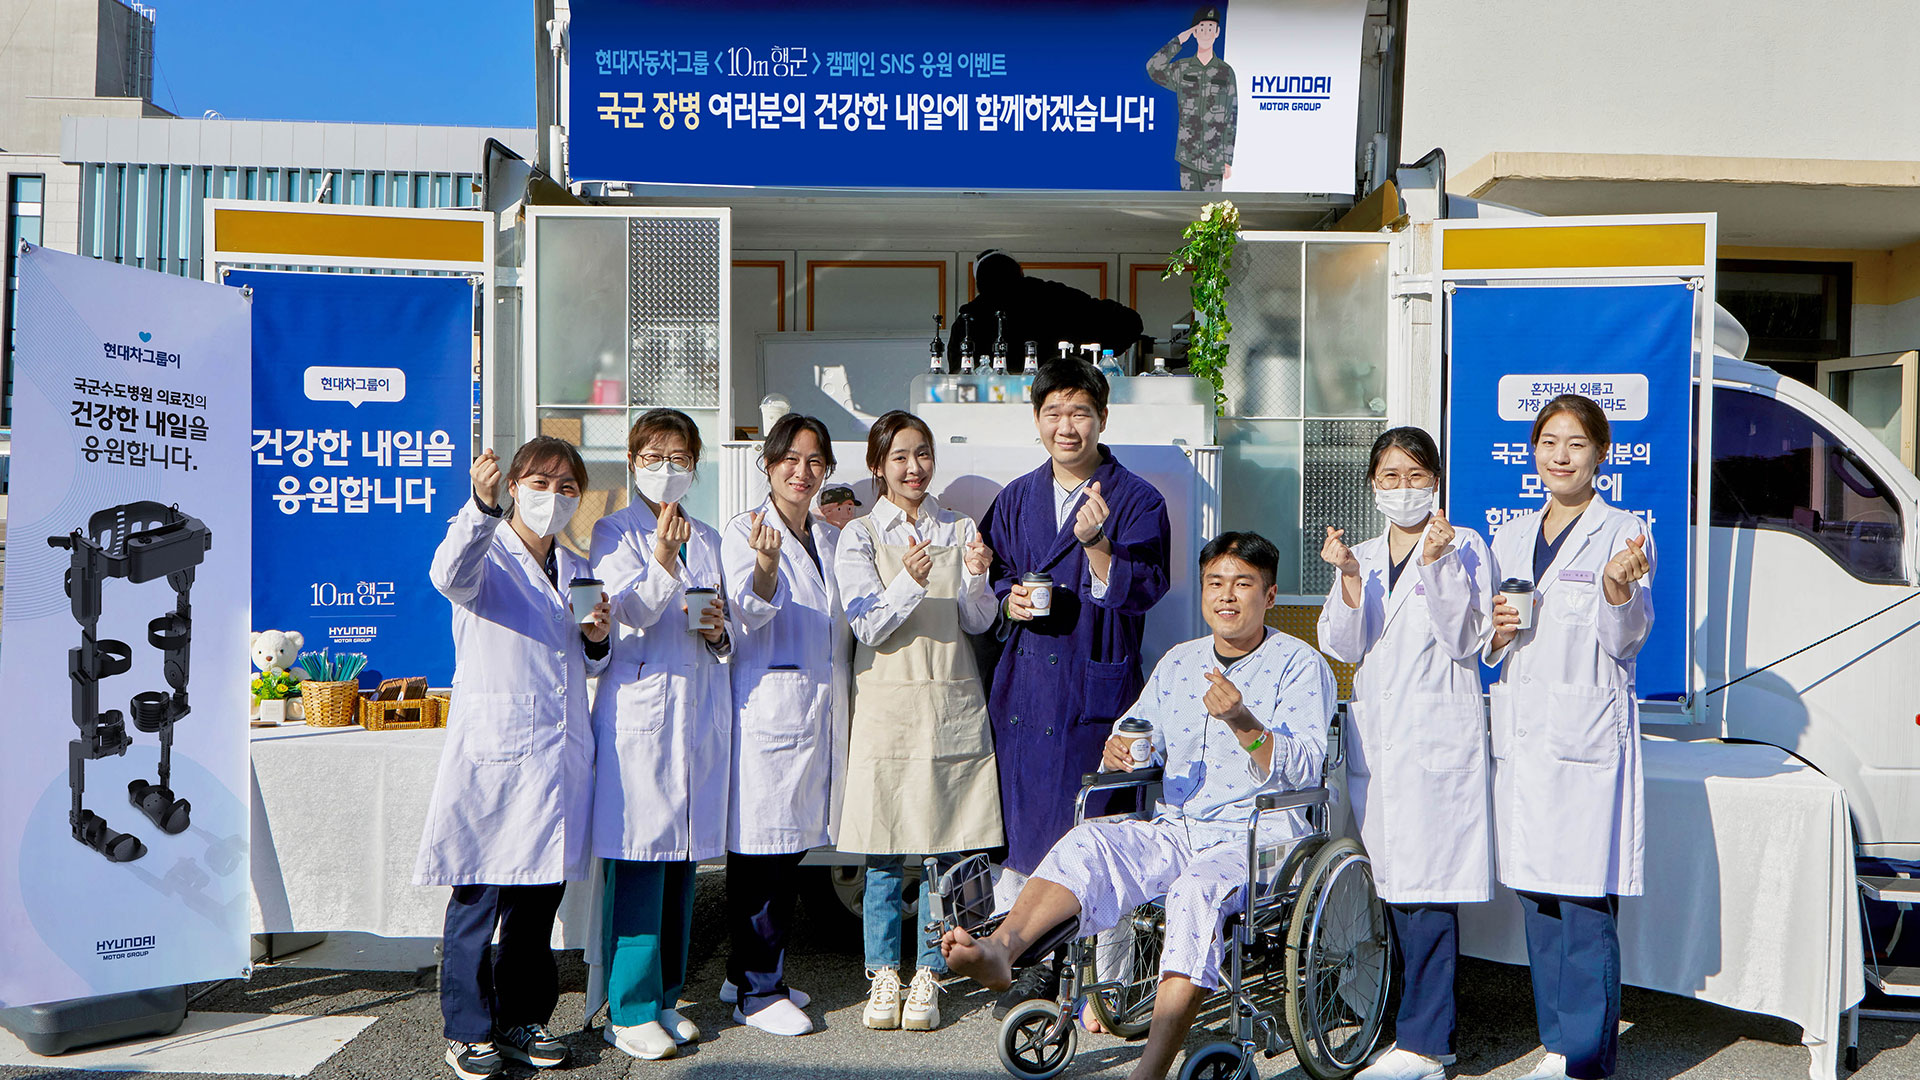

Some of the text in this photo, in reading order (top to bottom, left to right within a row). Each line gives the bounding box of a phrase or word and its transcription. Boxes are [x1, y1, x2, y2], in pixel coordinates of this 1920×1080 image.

[595, 49, 709, 76] 현대자동차그룹
[826, 51, 875, 77] 캠페인
[880, 53, 915, 74] SNS
[920, 52, 953, 78] 응원
[958, 52, 1007, 78] 이벤트
[1251, 76, 1331, 93] HYUNDAI
[597, 91, 1155, 133] 국군 장병 여러분의 건강한 내일에 함께하겠습니다!
[1259, 102, 1321, 111] MOTOR GROUP
[103, 342, 181, 369] 현대차그룹이
[73, 377, 207, 410] 국군수도병원 의료진의
[320, 377, 390, 391] 현대차그룹이
[1530, 382, 1614, 396] 혼자라서 외롭고
[1518, 398, 1541, 412] 가장
[70, 400, 209, 442] 건강한 내일을
[81, 435, 198, 472] 응원합니다.
[251, 428, 456, 468] 건강한 내일을
[1491, 442, 1529, 465] 국군
[272, 475, 437, 515] 응원합니다
[328, 626, 377, 635] HYUNDAI
[96, 935, 156, 951] HYUNDAI
[126, 950, 149, 958] GROUP
